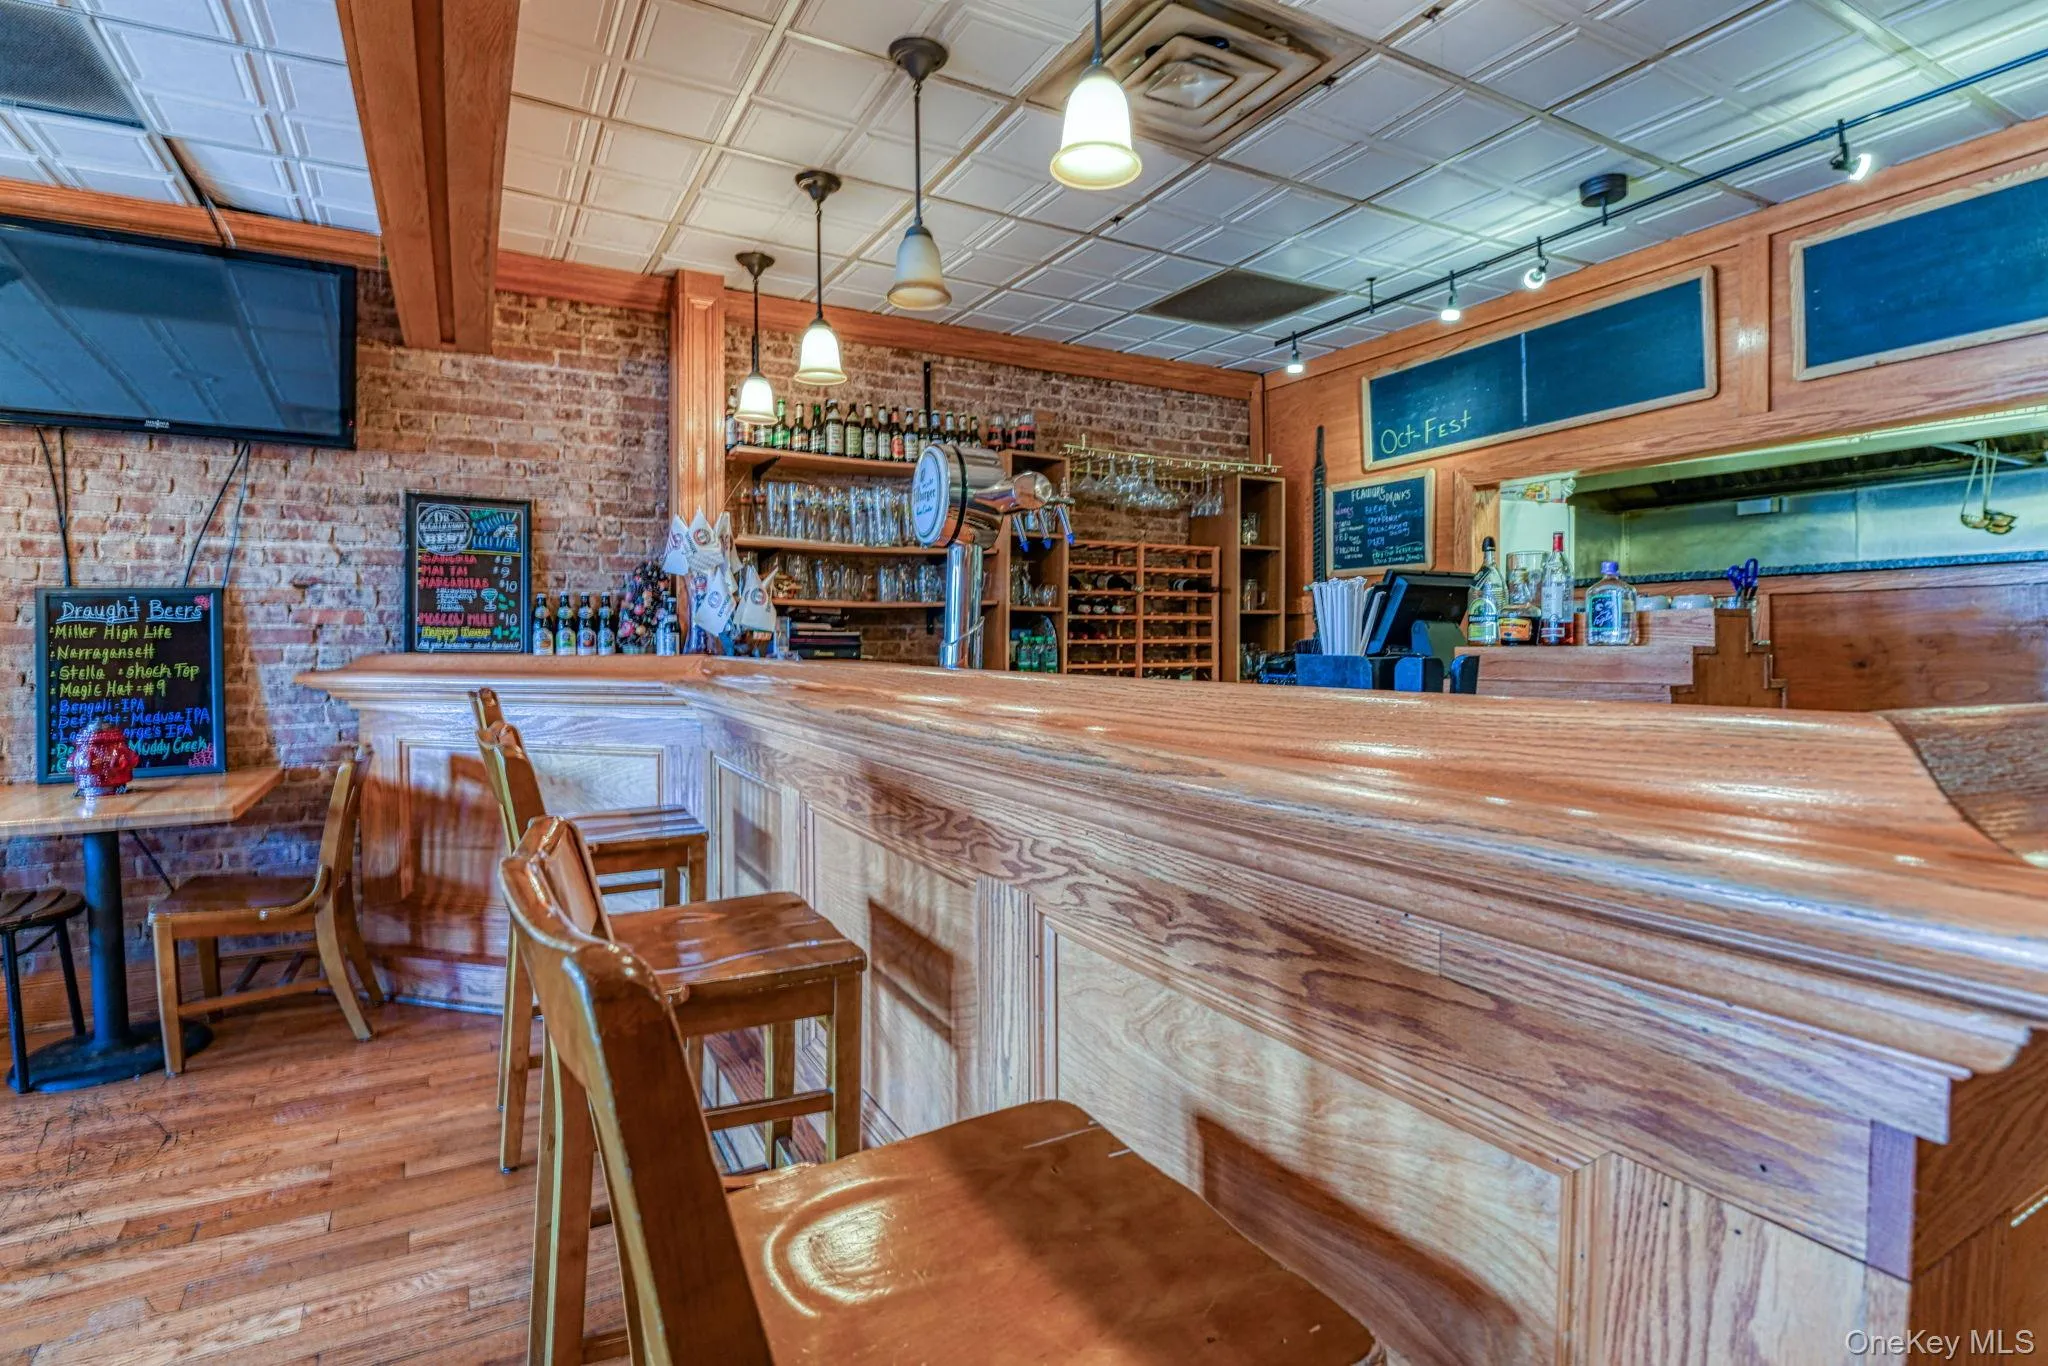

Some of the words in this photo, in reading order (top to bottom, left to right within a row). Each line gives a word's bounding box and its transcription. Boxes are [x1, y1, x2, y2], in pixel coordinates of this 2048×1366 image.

[449, 565, 468, 576] TAI
[60, 597, 140, 623] Draught
[148, 599, 203, 620] Beers
[55, 625, 97, 639] Miller
[104, 626, 139, 642] High
[144, 625, 173, 639] Life
[57, 645, 156, 664] Narragansett
[59, 666, 106, 680] Stella
[174, 663, 200, 681] Top
[60, 684, 103, 700] Magic
[106, 680, 134, 695] Hat
[185, 707, 210, 725] IPA
[165, 720, 193, 738] IPA
[128, 737, 171, 760] Muddy
[173, 736, 208, 755] Creek
